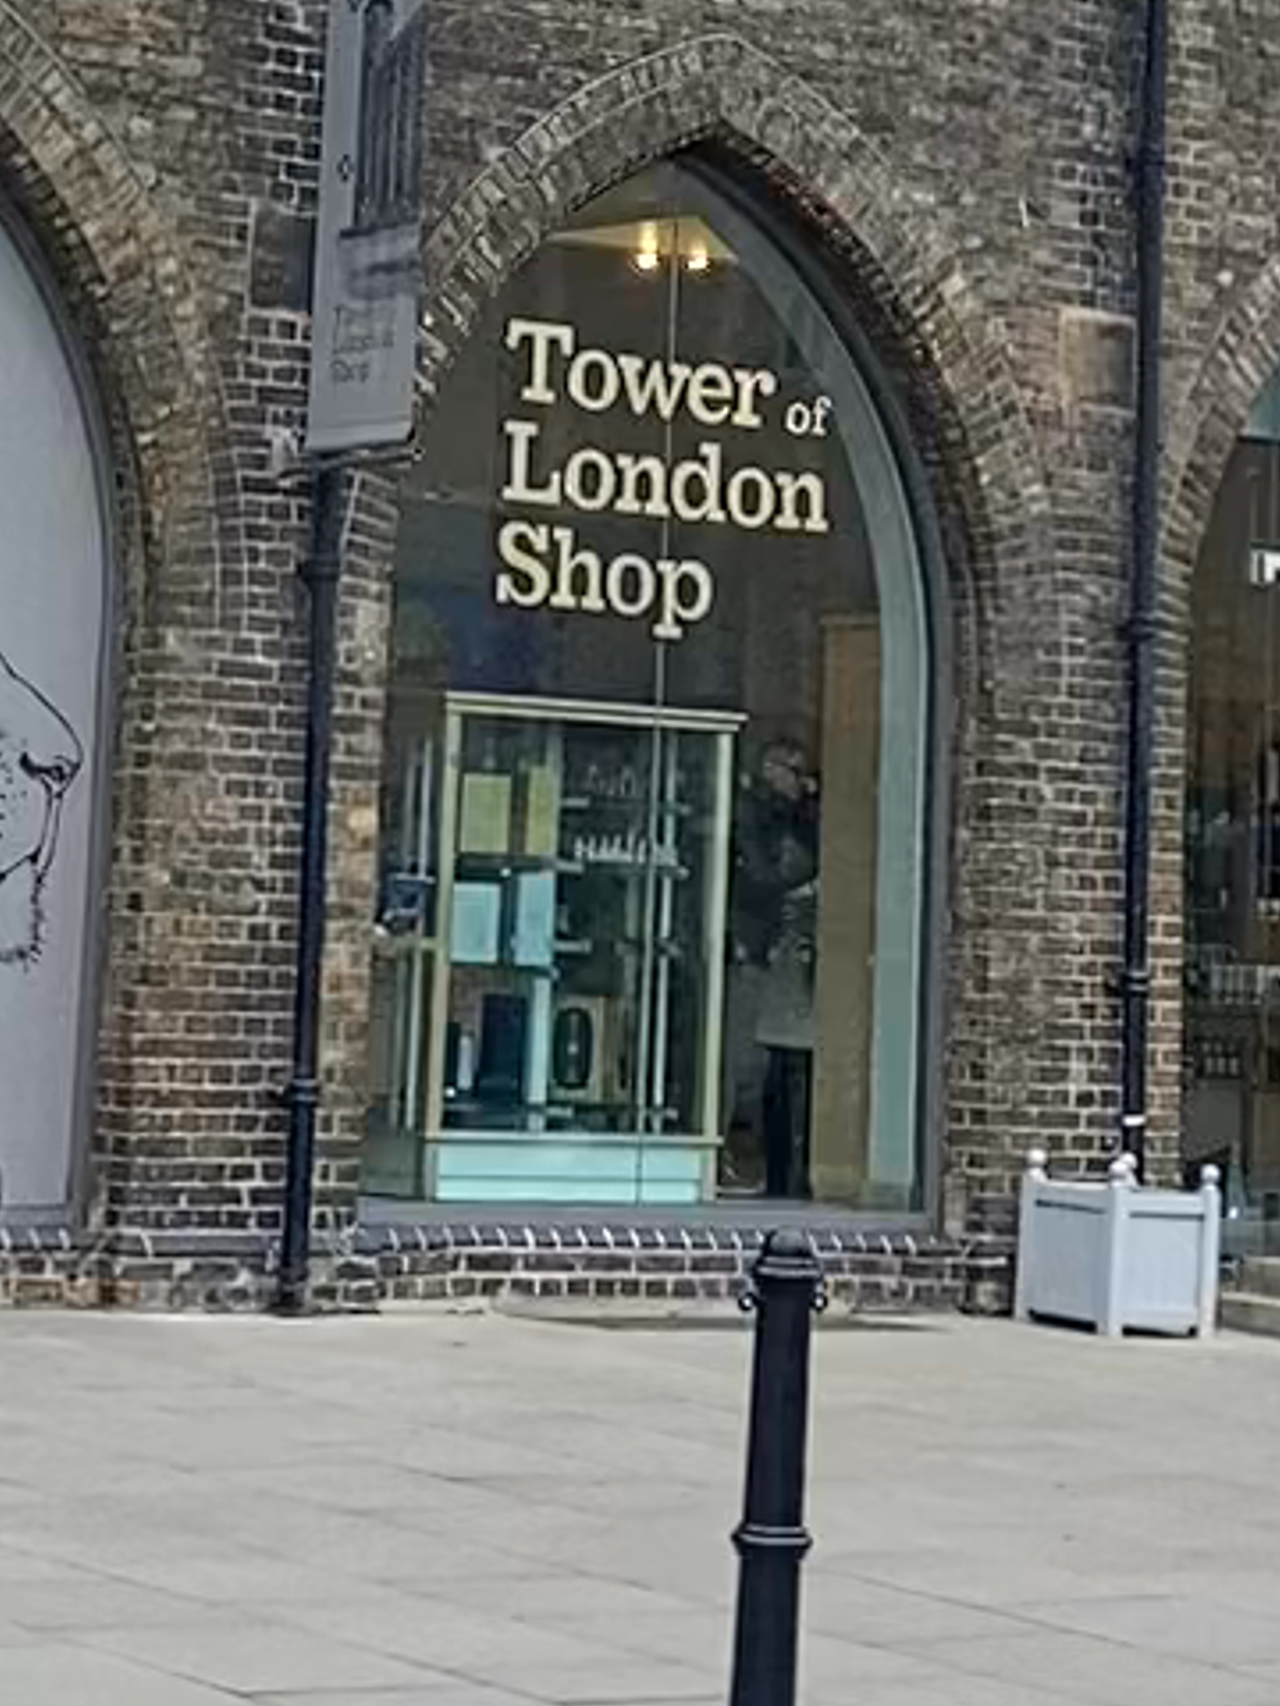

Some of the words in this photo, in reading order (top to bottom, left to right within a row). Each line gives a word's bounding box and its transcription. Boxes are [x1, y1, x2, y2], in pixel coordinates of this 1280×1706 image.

[506, 317, 777, 428] Tower
[785, 396, 833, 436] of
[502, 420, 828, 533] London
[496, 520, 713, 639] Shop
